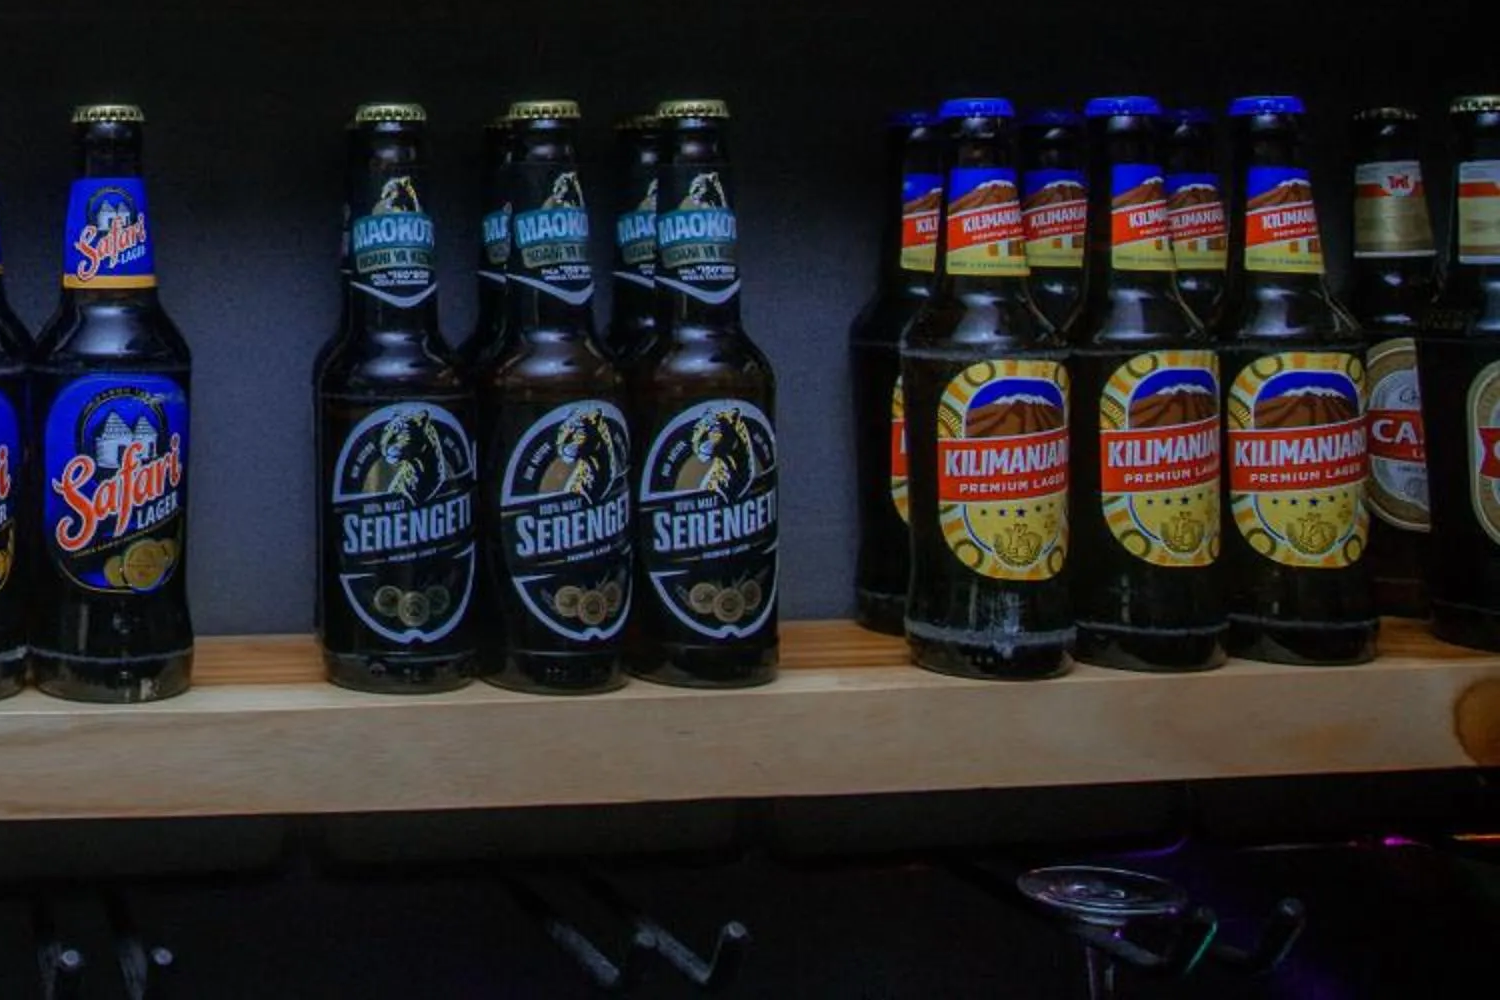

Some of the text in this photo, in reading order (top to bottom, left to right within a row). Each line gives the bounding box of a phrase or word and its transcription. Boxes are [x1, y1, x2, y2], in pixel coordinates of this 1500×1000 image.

[73, 211, 147, 283] Safari
[959, 481, 1029, 495] PREMIUM
[1123, 470, 1191, 486] PREMIUM
[1249, 470, 1321, 485] PREMIUM
[51, 431, 183, 553] Safari
[135, 491, 179, 530] LAGER
